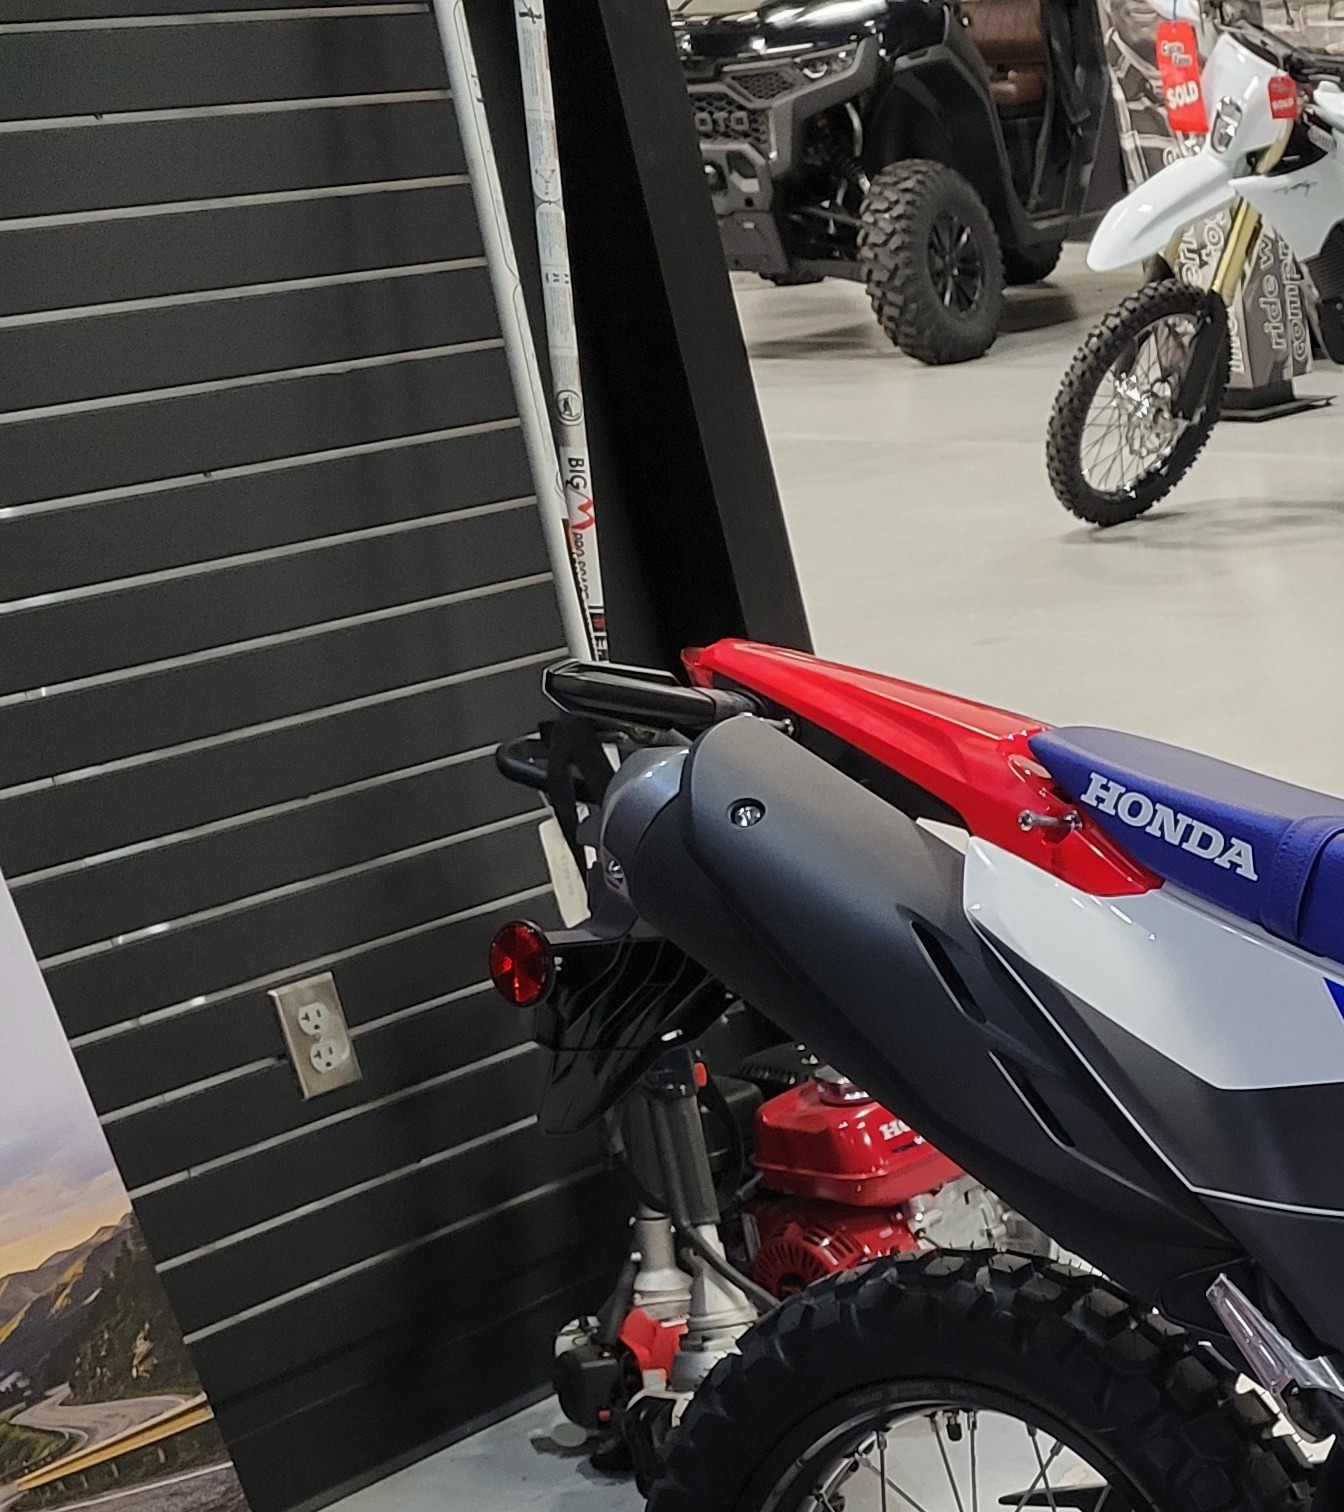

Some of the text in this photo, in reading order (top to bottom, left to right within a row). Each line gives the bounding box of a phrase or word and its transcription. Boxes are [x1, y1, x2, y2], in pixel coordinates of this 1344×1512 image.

[1167, 80, 1199, 110] SOLD
[1260, 274, 1287, 350] ride
[1080, 771, 1258, 882] HONDA
